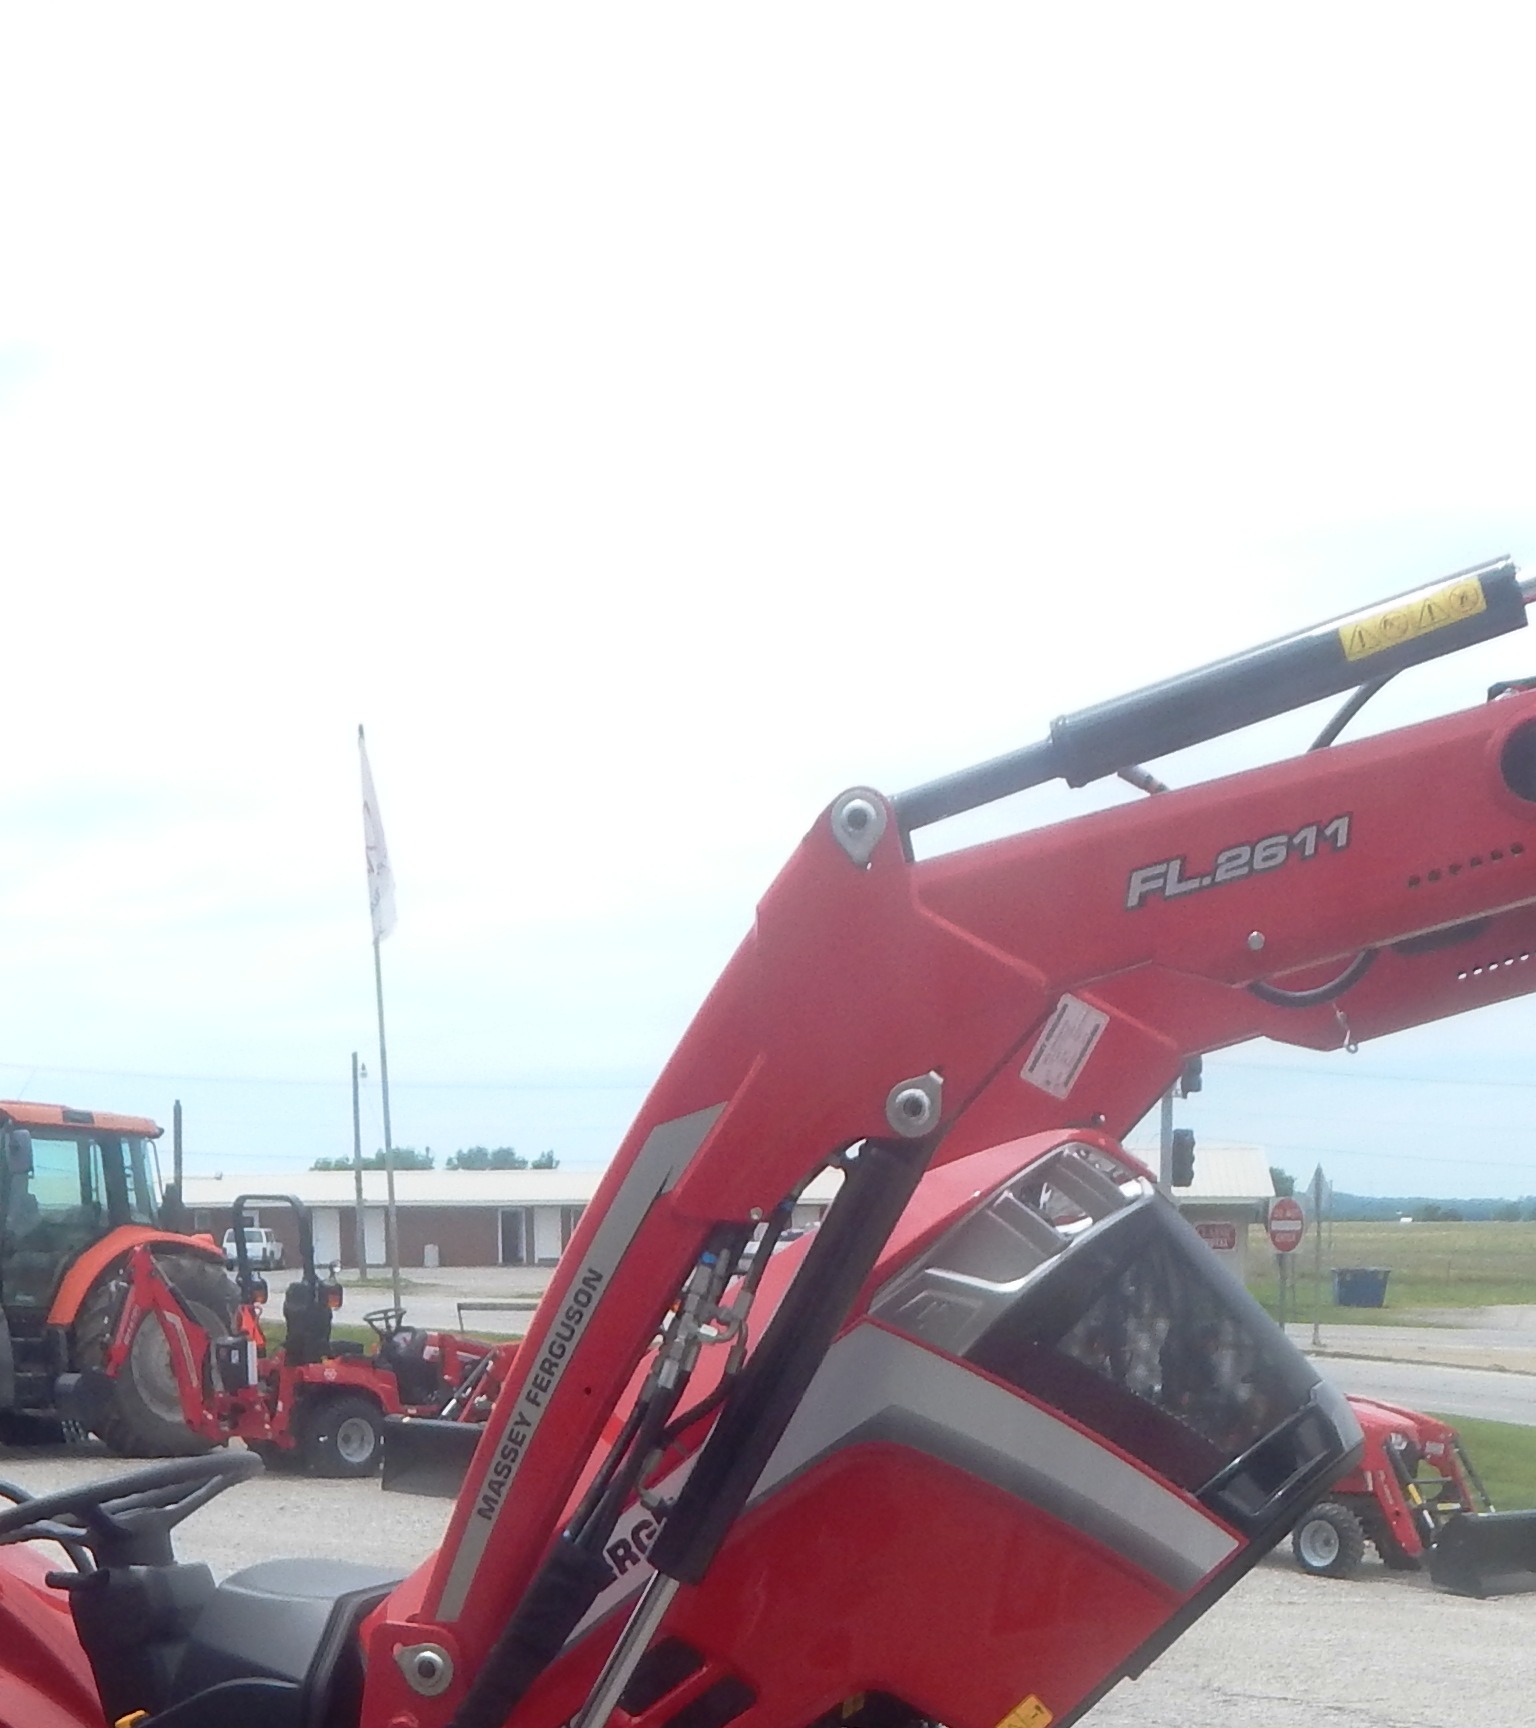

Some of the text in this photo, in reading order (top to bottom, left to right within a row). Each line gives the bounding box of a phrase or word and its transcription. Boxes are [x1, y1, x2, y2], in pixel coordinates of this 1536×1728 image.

[1126, 814, 1350, 909] FL.2611
[476, 1267, 604, 1521] MASSEY FERGUSON
